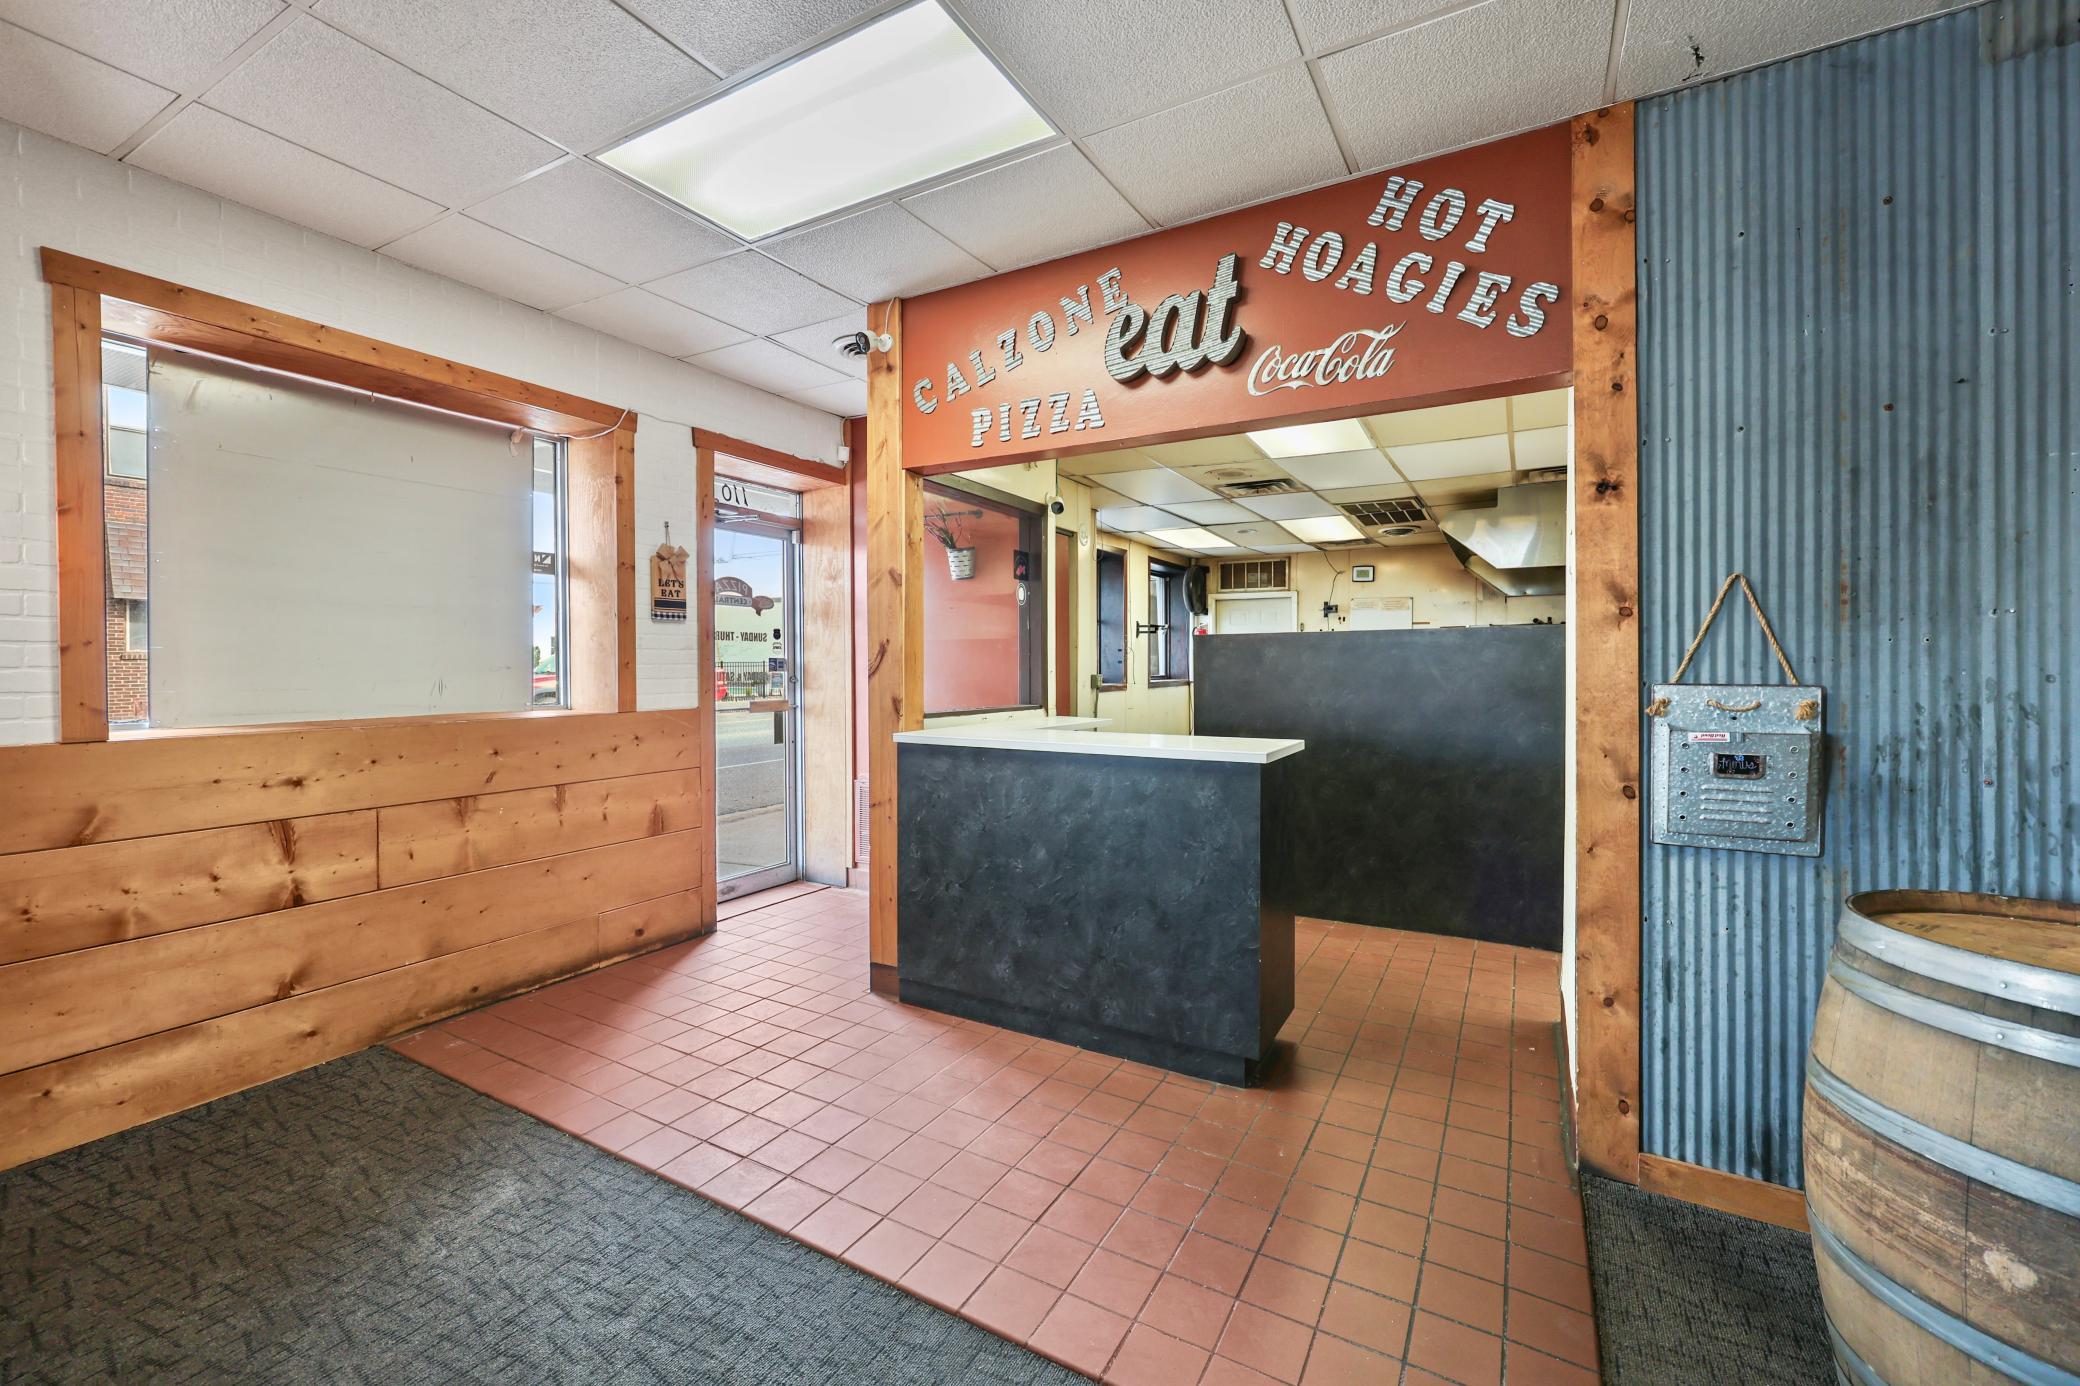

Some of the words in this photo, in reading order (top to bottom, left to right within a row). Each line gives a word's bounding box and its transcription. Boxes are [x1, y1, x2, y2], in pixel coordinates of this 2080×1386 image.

[1367, 176, 1515, 253] HOT
[1104, 251, 1247, 383] eat
[1259, 221, 1559, 338] HOAGIES
[913, 267, 1129, 414] CALZONE
[970, 388, 1106, 447] PIZZA
[658, 578, 684, 589] LET'S
[660, 588, 681, 598] EAT
